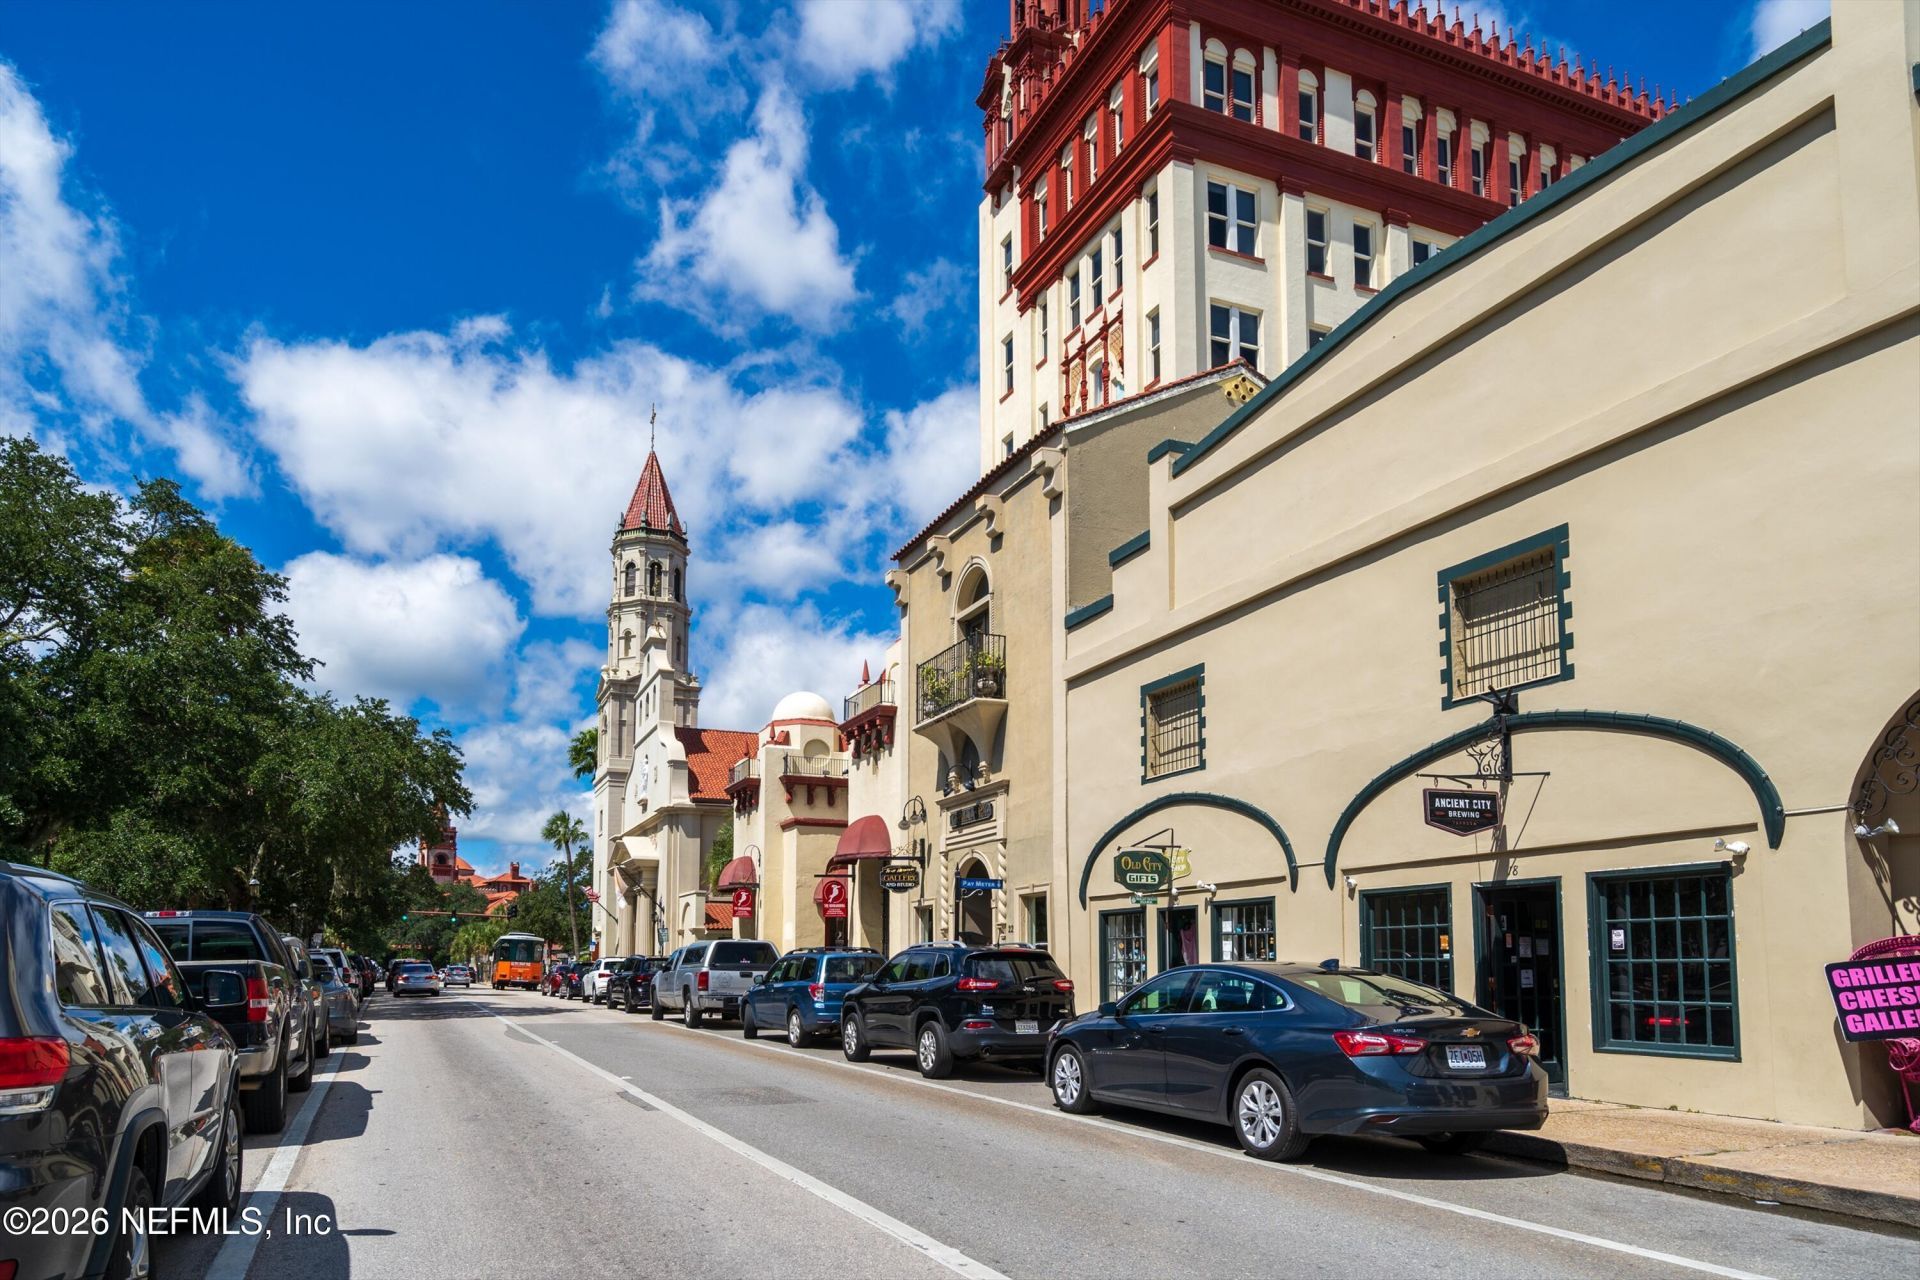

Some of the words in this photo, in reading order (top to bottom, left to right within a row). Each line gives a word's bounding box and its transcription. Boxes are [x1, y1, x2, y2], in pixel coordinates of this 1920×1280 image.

[1435, 798, 1469, 808] ANCIENT
[1472, 799, 1491, 810] CITY
[1846, 1009, 1920, 1033] GALLE
